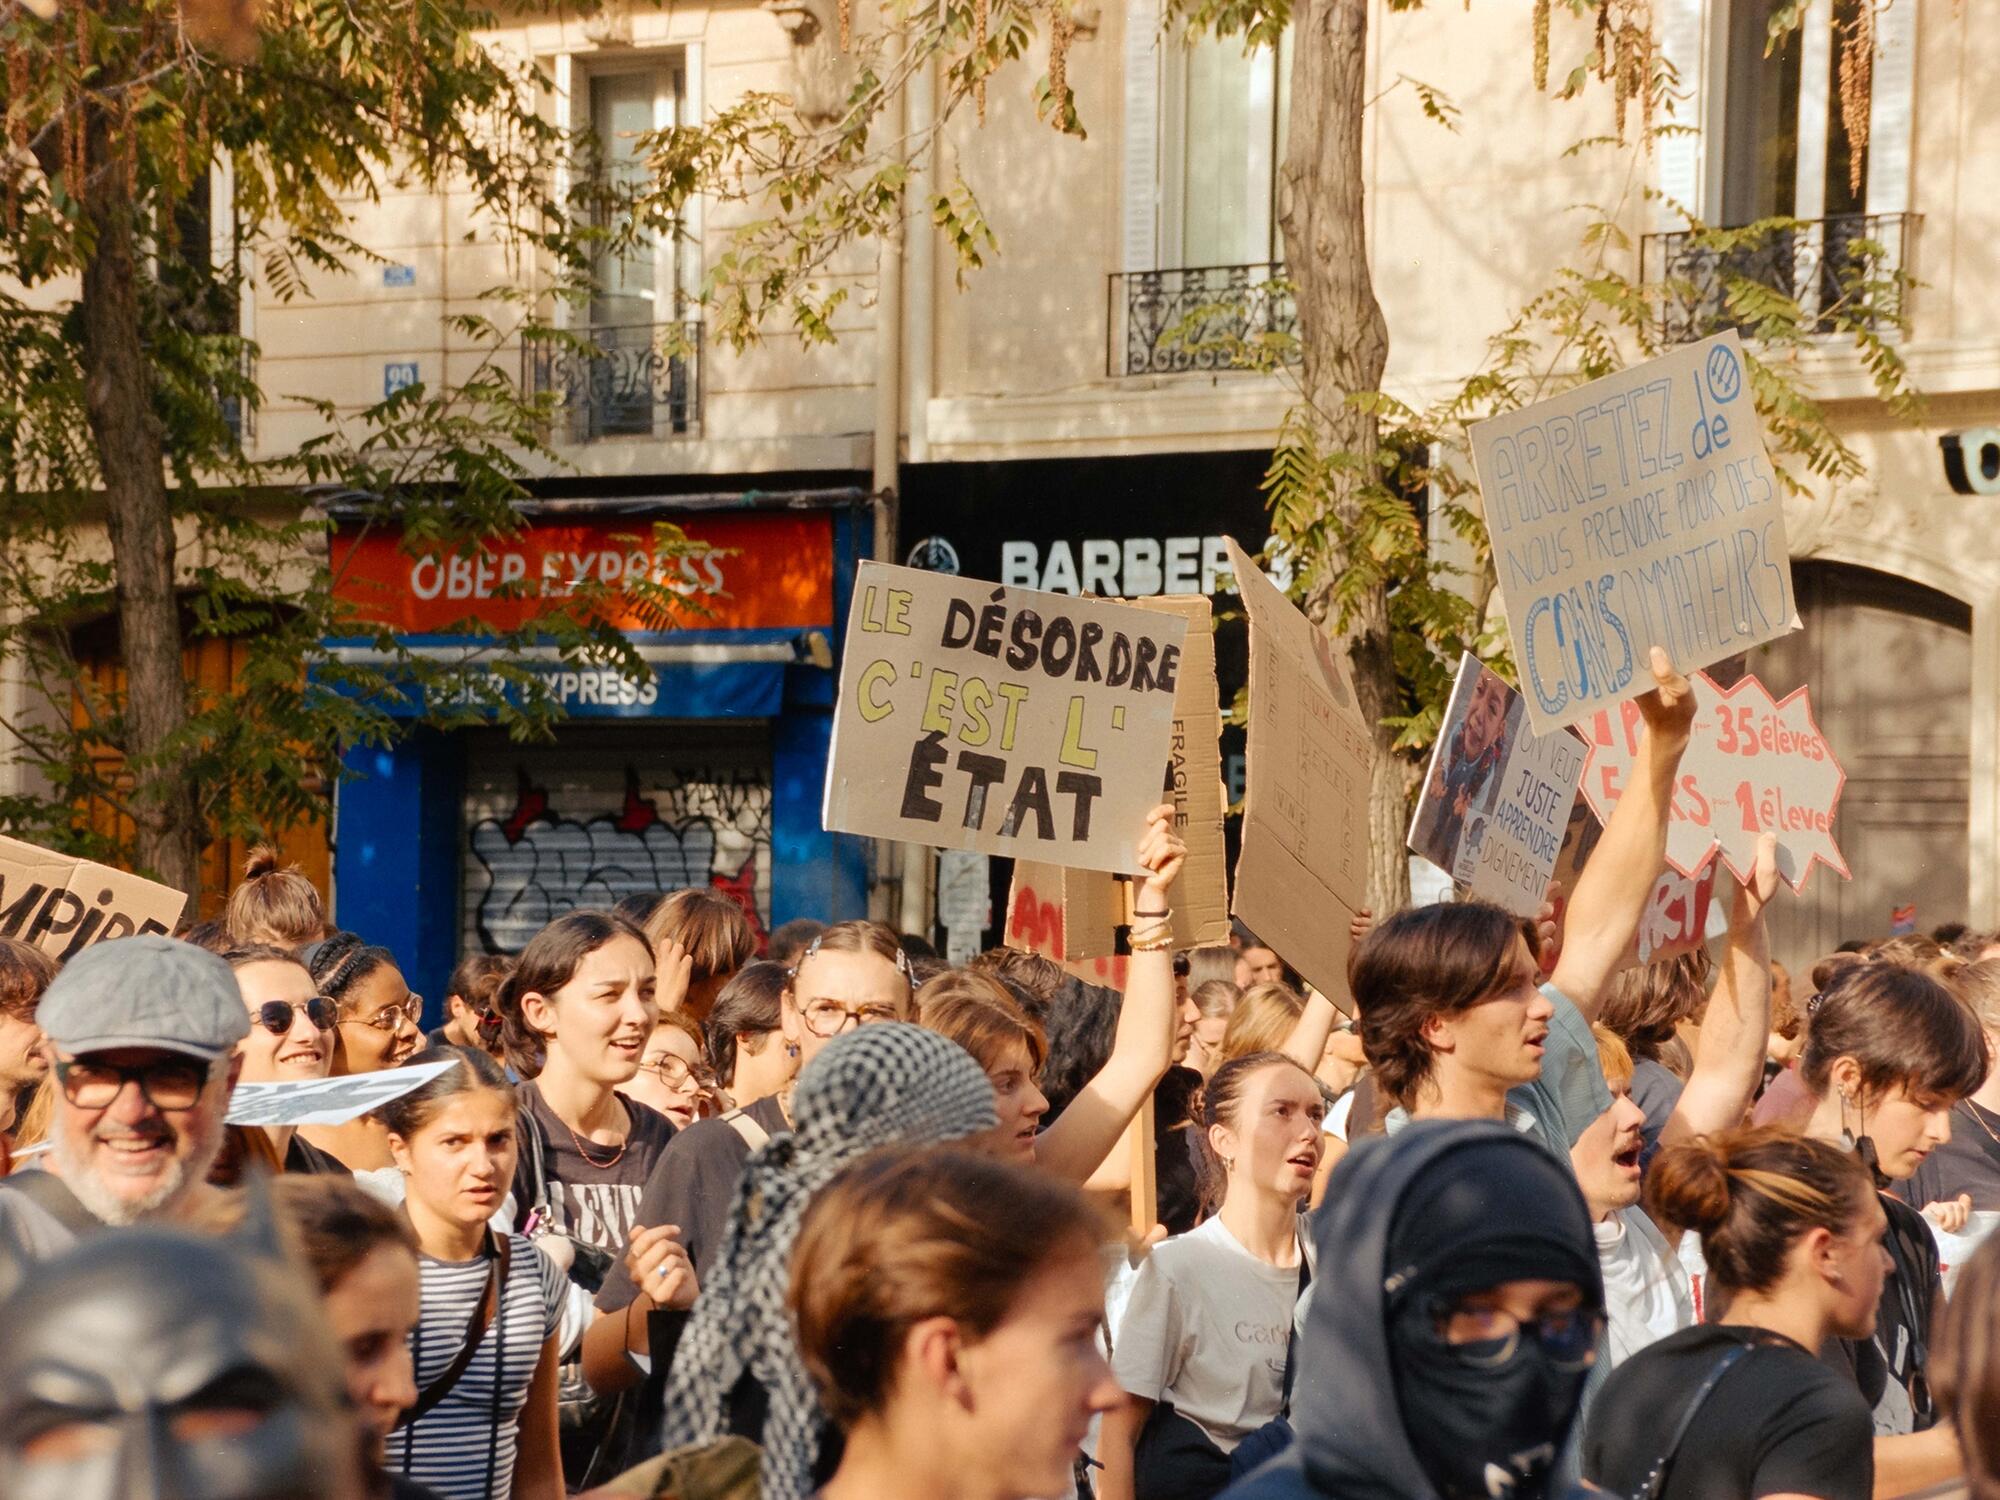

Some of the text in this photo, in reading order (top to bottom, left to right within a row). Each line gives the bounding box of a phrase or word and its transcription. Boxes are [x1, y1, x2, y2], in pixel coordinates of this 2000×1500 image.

[1489, 370, 1731, 533] ARRETEZ de
[1507, 454, 1773, 591] NOUS PRENDRE POUR DES
[411, 552, 526, 600] OBER
[1525, 520, 1787, 715] CONSOMMATEURS
[861, 585, 913, 636] LE
[940, 586, 1181, 693] DÉSORDRE
[857, 659, 1126, 770] C'EST L'
[1714, 704, 1761, 757] 35
[900, 729, 1103, 842] ÉTAT
[1172, 720, 1189, 828] FRAGILE
[1516, 769, 1562, 825] JUSTE
[1549, 745, 1583, 788] VEUT
[1735, 781, 1761, 833] 1
[1480, 835, 1550, 900] DIGNEMENT
[1494, 798, 1559, 864] APPRENDRE
